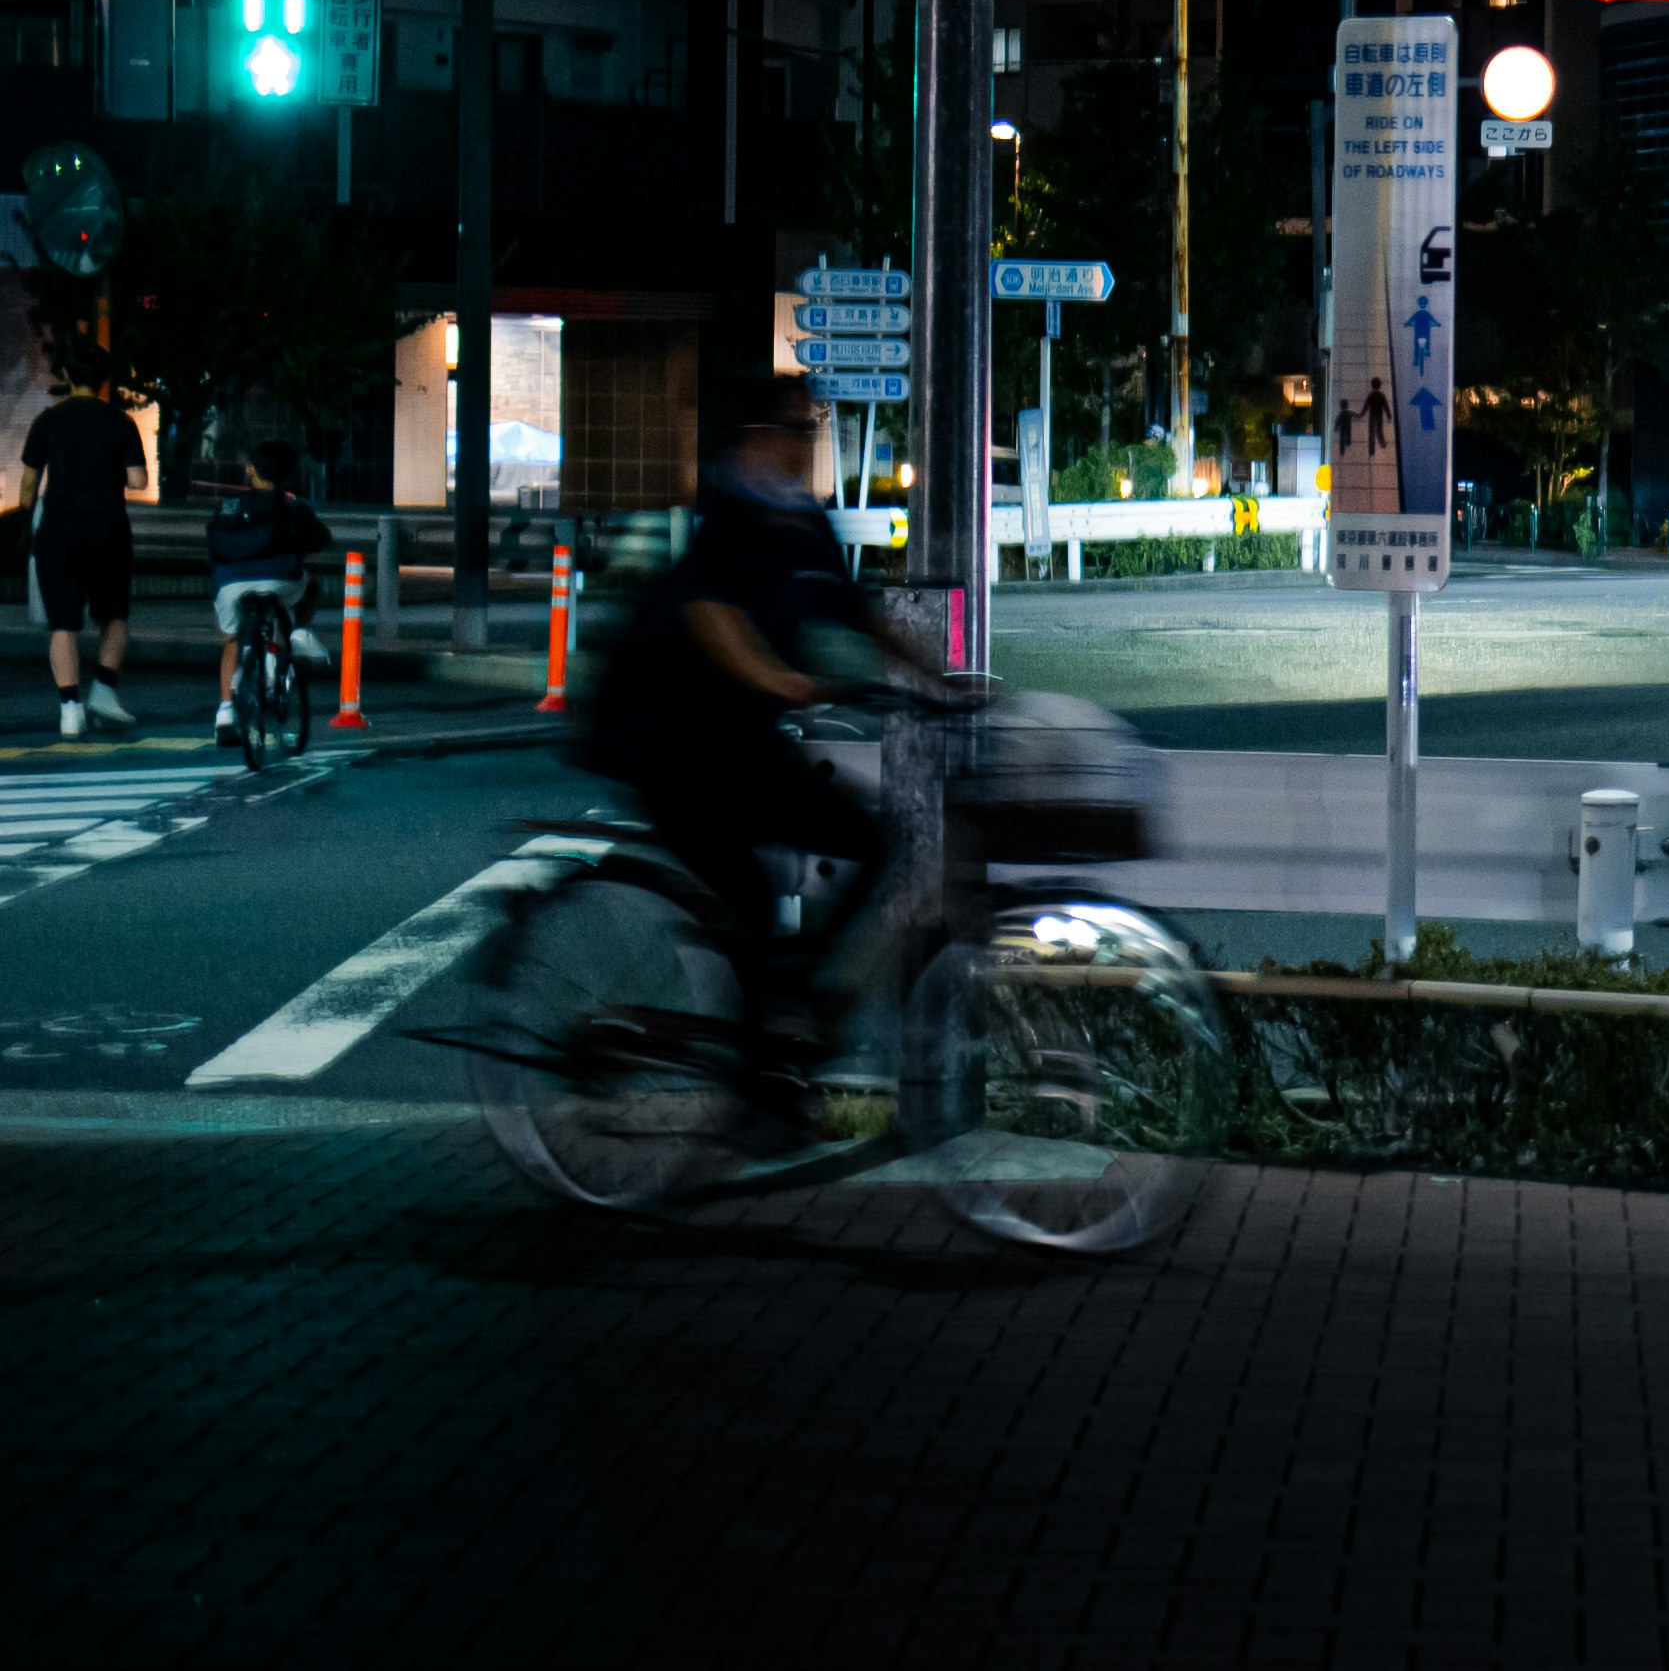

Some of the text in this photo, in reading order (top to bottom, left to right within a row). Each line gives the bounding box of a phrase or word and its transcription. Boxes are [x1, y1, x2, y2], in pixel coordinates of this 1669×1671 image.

[1344, 42, 1447, 64] 自転車は原則
[1345, 72, 1447, 98] 車道の左側
[1365, 115, 1424, 130] RIDE ON
[1485, 127, 1548, 141] ここから
[1344, 140, 1445, 154] THE LEFT SIDE
[1343, 165, 1445, 179] OF ROADWAYS
[1030, 266, 1094, 284] 明治通り
